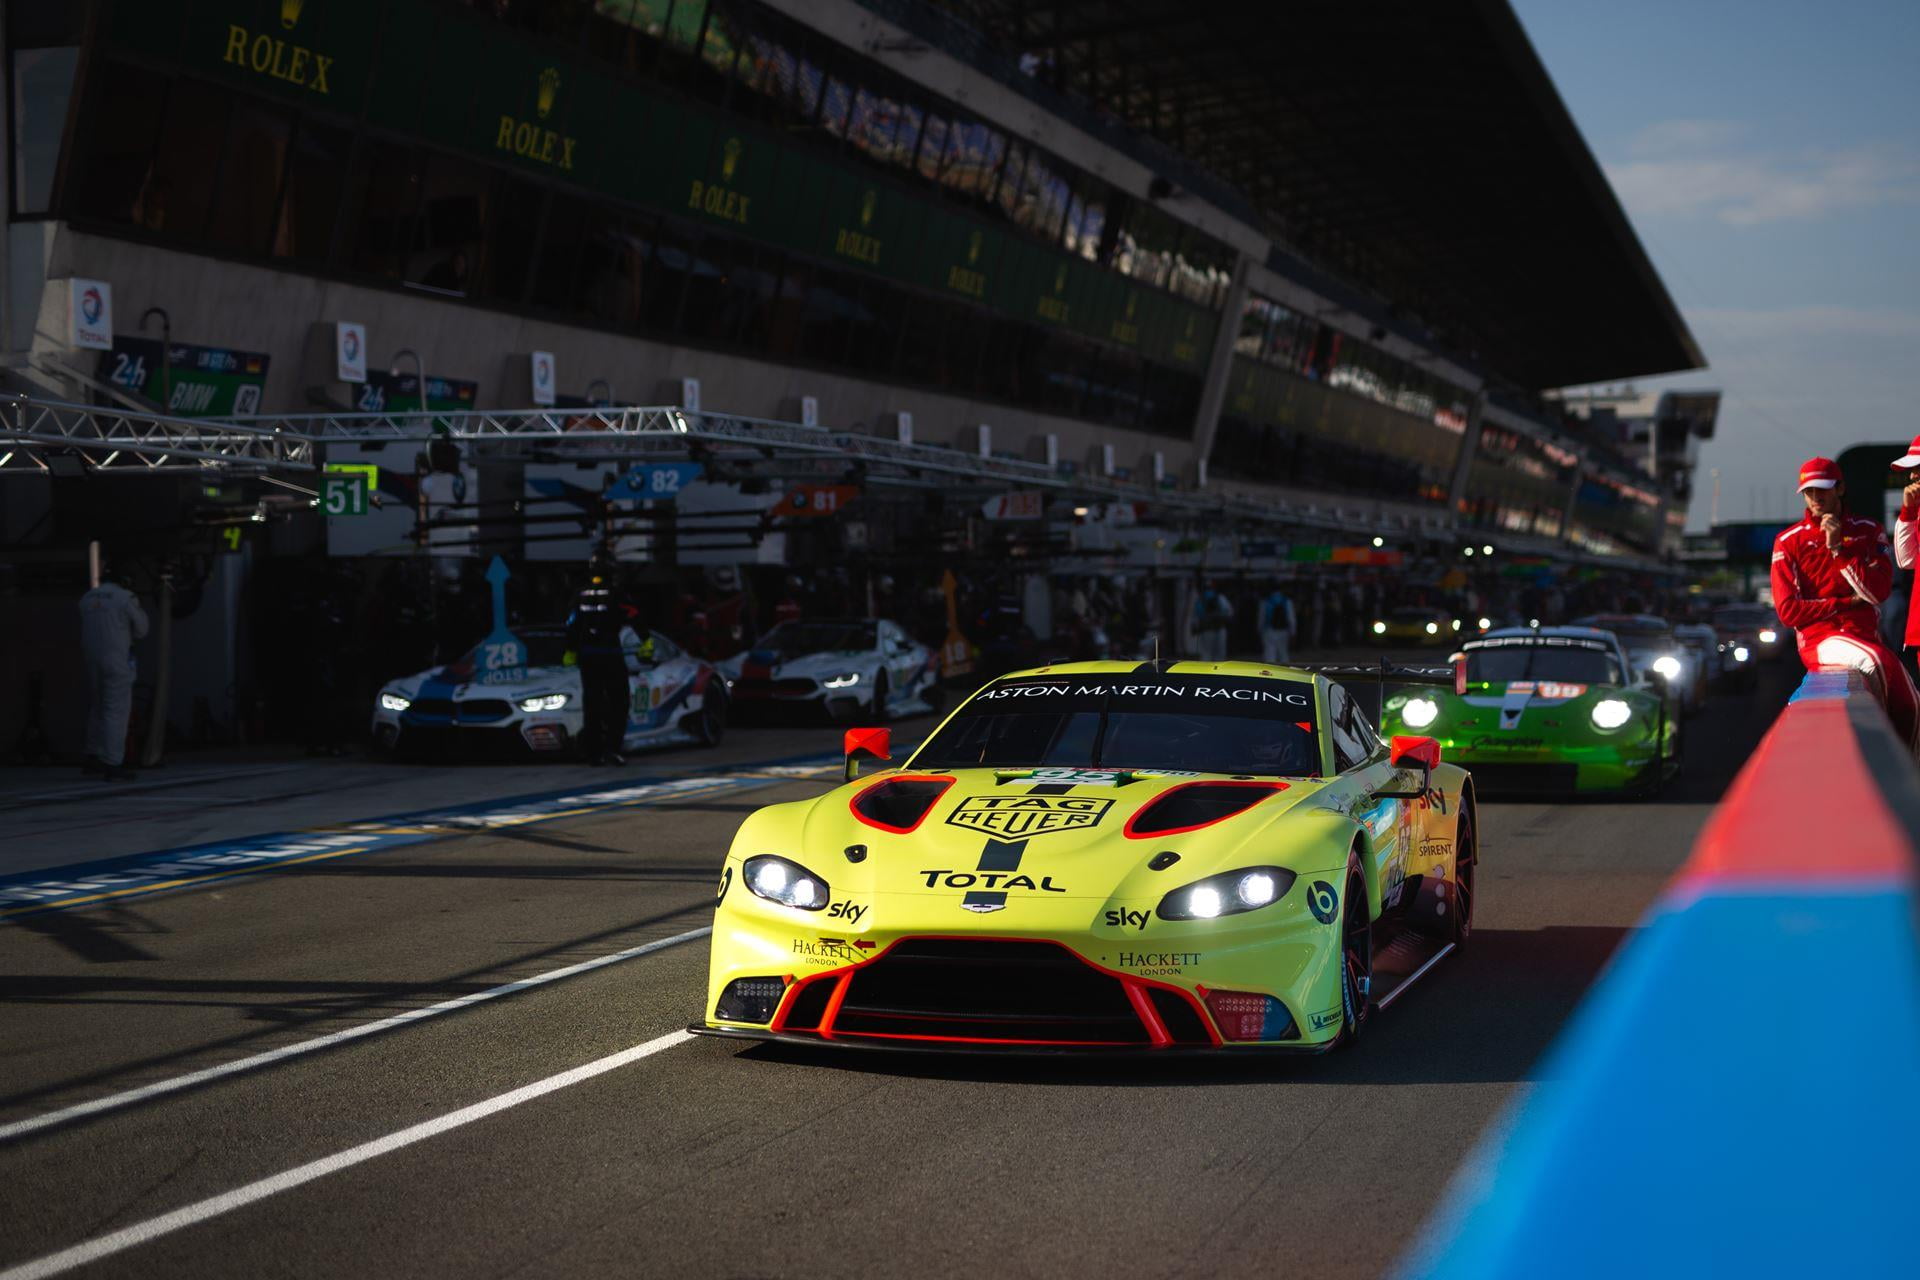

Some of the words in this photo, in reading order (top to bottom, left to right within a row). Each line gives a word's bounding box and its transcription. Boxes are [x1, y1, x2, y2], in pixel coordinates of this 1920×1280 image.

[223, 24, 334, 95] ROLEX
[496, 115, 577, 171] ROLEX
[688, 180, 750, 225] ROLEX
[169, 381, 217, 412] BMW
[651, 469, 680, 492] 82
[325, 479, 362, 513] 51
[813, 490, 836, 511] 81
[977, 685, 1072, 701] ASTON
[1074, 685, 1185, 697] MARTIN
[1194, 686, 1308, 706] RACING
[1032, 769, 1115, 781] 95
[978, 798, 1097, 810] TAG
[958, 811, 1090, 835] HEUER
[1418, 843, 1453, 858] SPIRENT
[920, 869, 1067, 893] TOTAL
[827, 900, 869, 925] sky
[1105, 906, 1152, 931] sky
[805, 957, 839, 967] LONDON
[1119, 952, 1202, 967] HACKETT
[1139, 967, 1182, 976] LONDON
